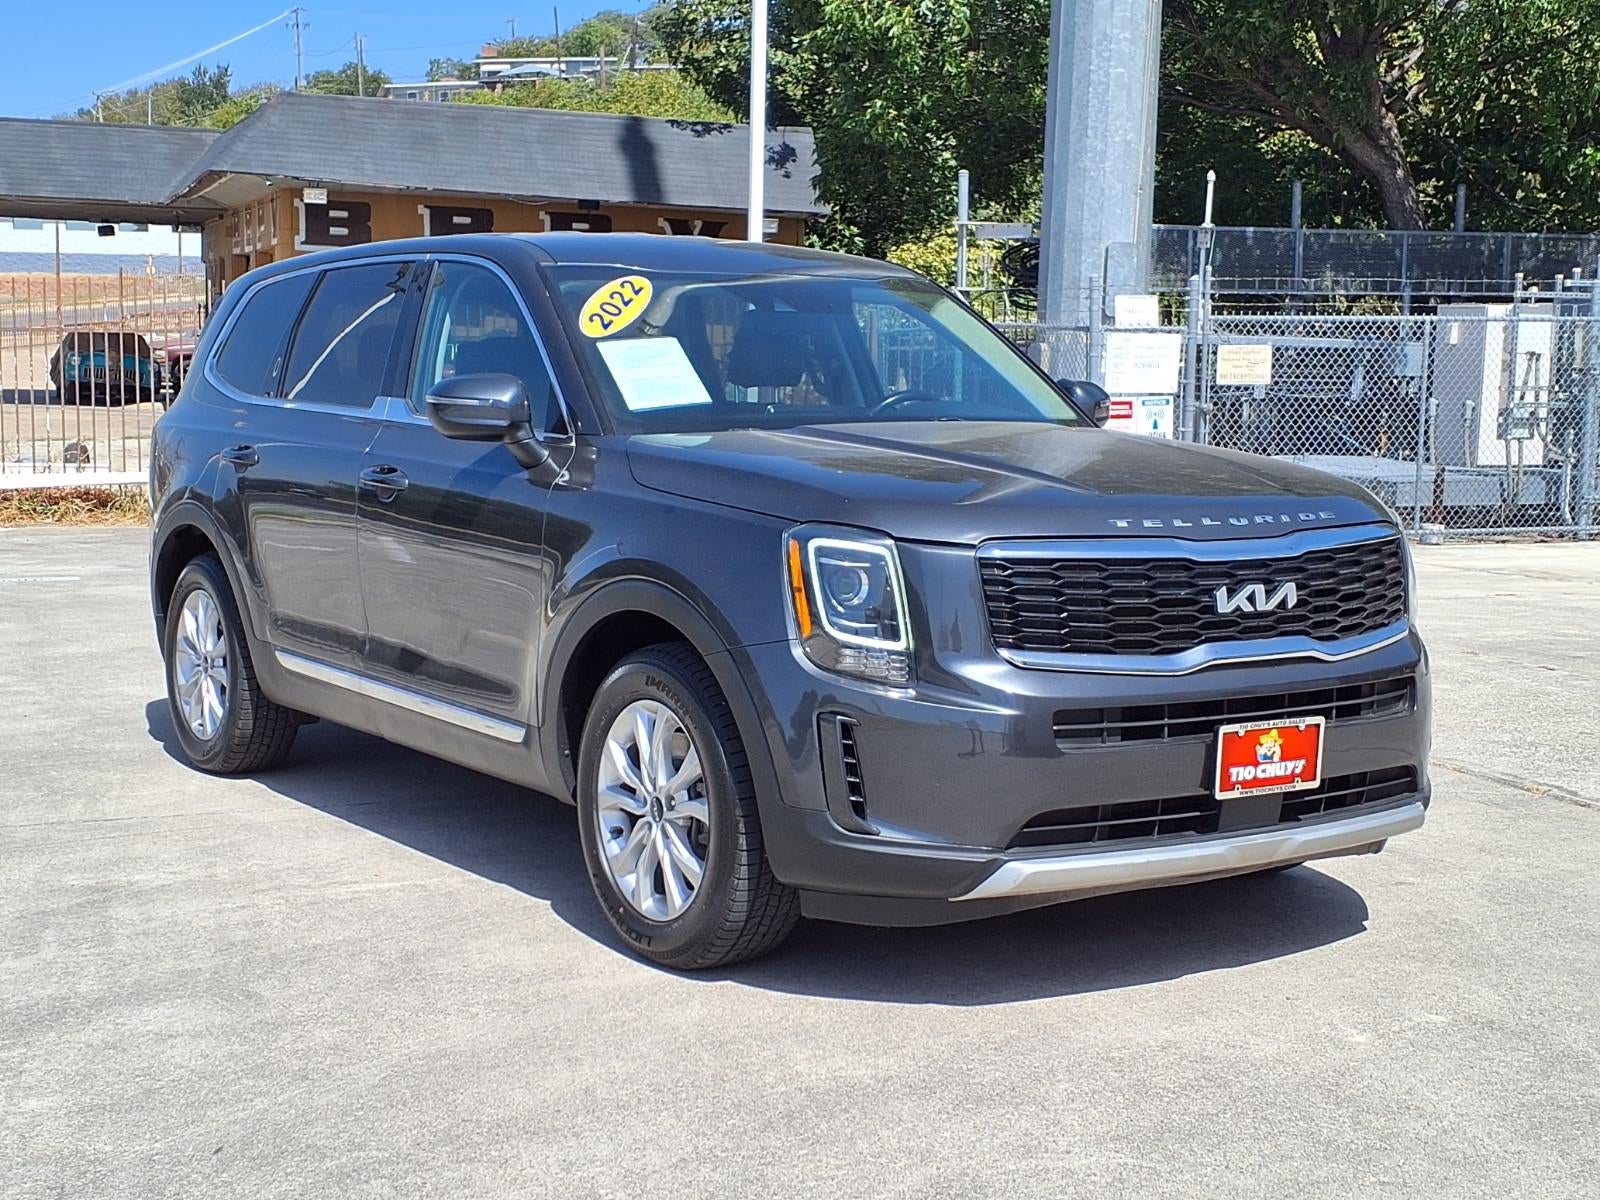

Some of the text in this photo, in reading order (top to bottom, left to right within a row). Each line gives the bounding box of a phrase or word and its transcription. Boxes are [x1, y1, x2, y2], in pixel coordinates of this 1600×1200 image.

[588, 280, 644, 330] 2022
[1108, 511, 1337, 528] TELLURIDE
[1215, 582, 1298, 614] KIA
